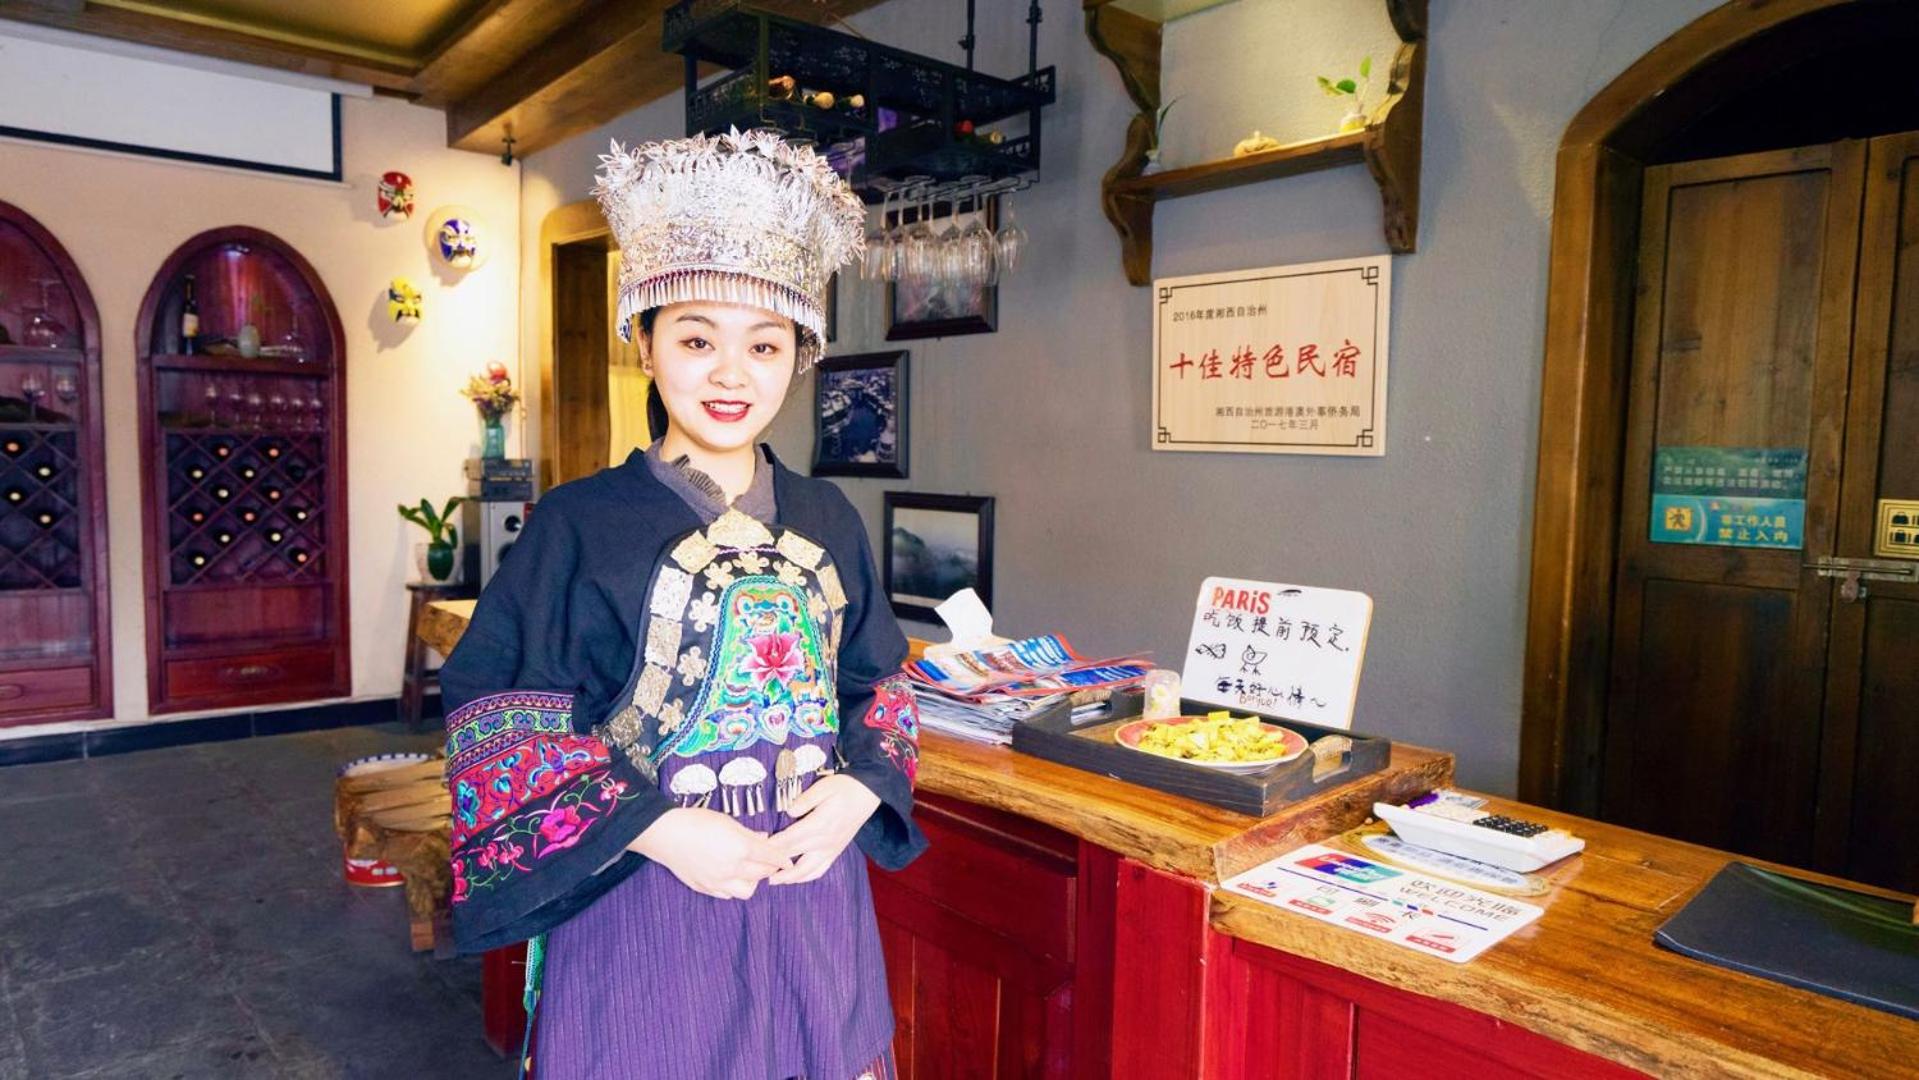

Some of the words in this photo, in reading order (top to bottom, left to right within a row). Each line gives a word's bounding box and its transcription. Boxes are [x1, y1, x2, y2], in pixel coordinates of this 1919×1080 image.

[1169, 339, 1361, 380] 十佳特色民宿
[1399, 887, 1510, 921] WELCOME
